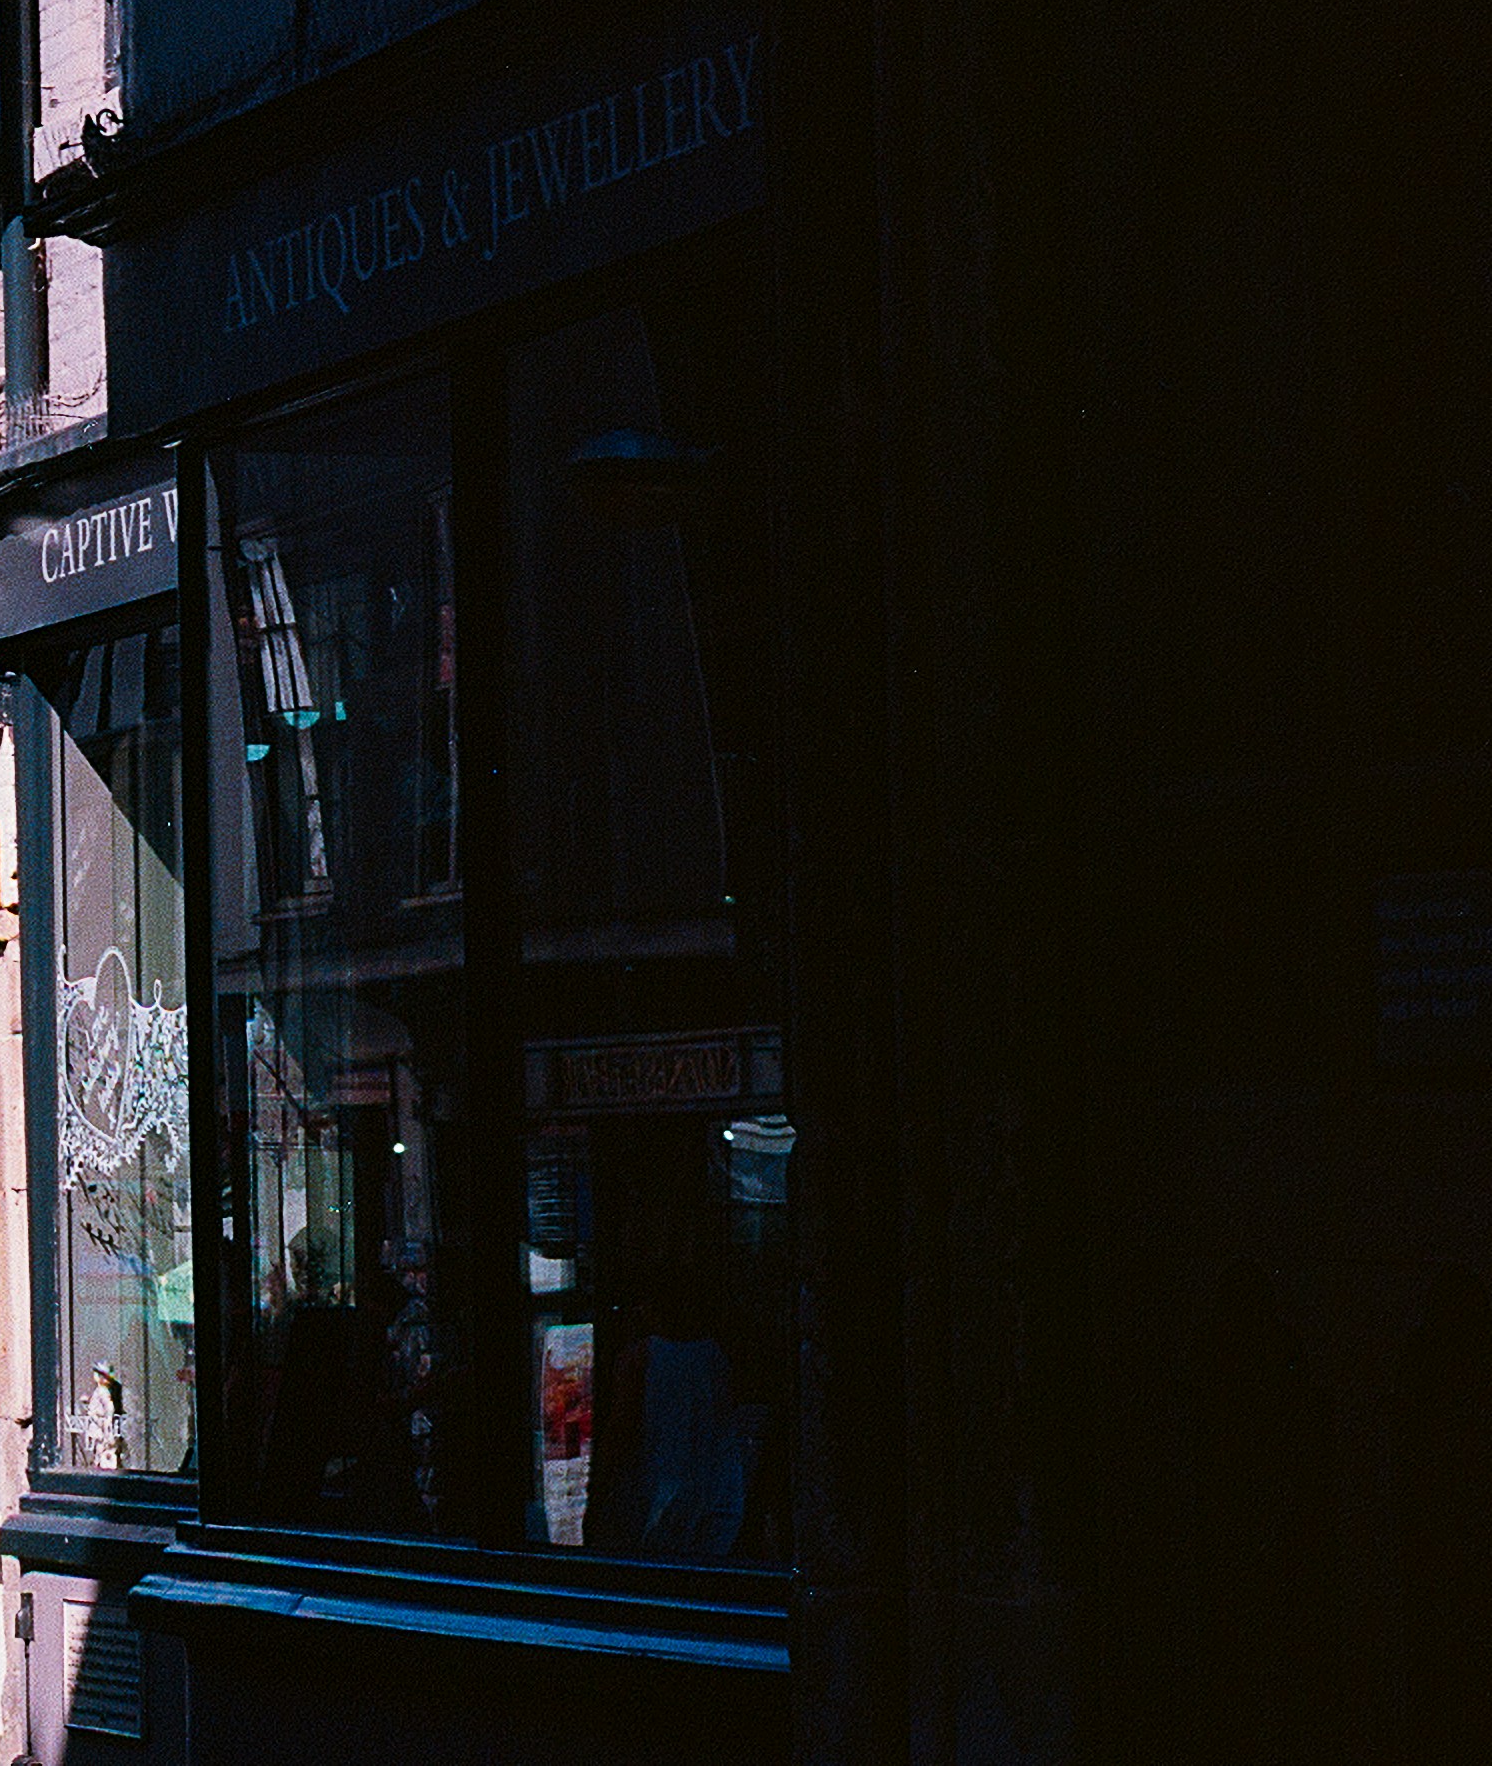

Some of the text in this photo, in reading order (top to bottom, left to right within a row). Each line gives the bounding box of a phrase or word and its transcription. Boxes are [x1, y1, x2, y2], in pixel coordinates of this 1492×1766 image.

[223, 34, 761, 333] ANTIQUES & JEWELLERY
[41, 497, 153, 583] CAPTIVE
